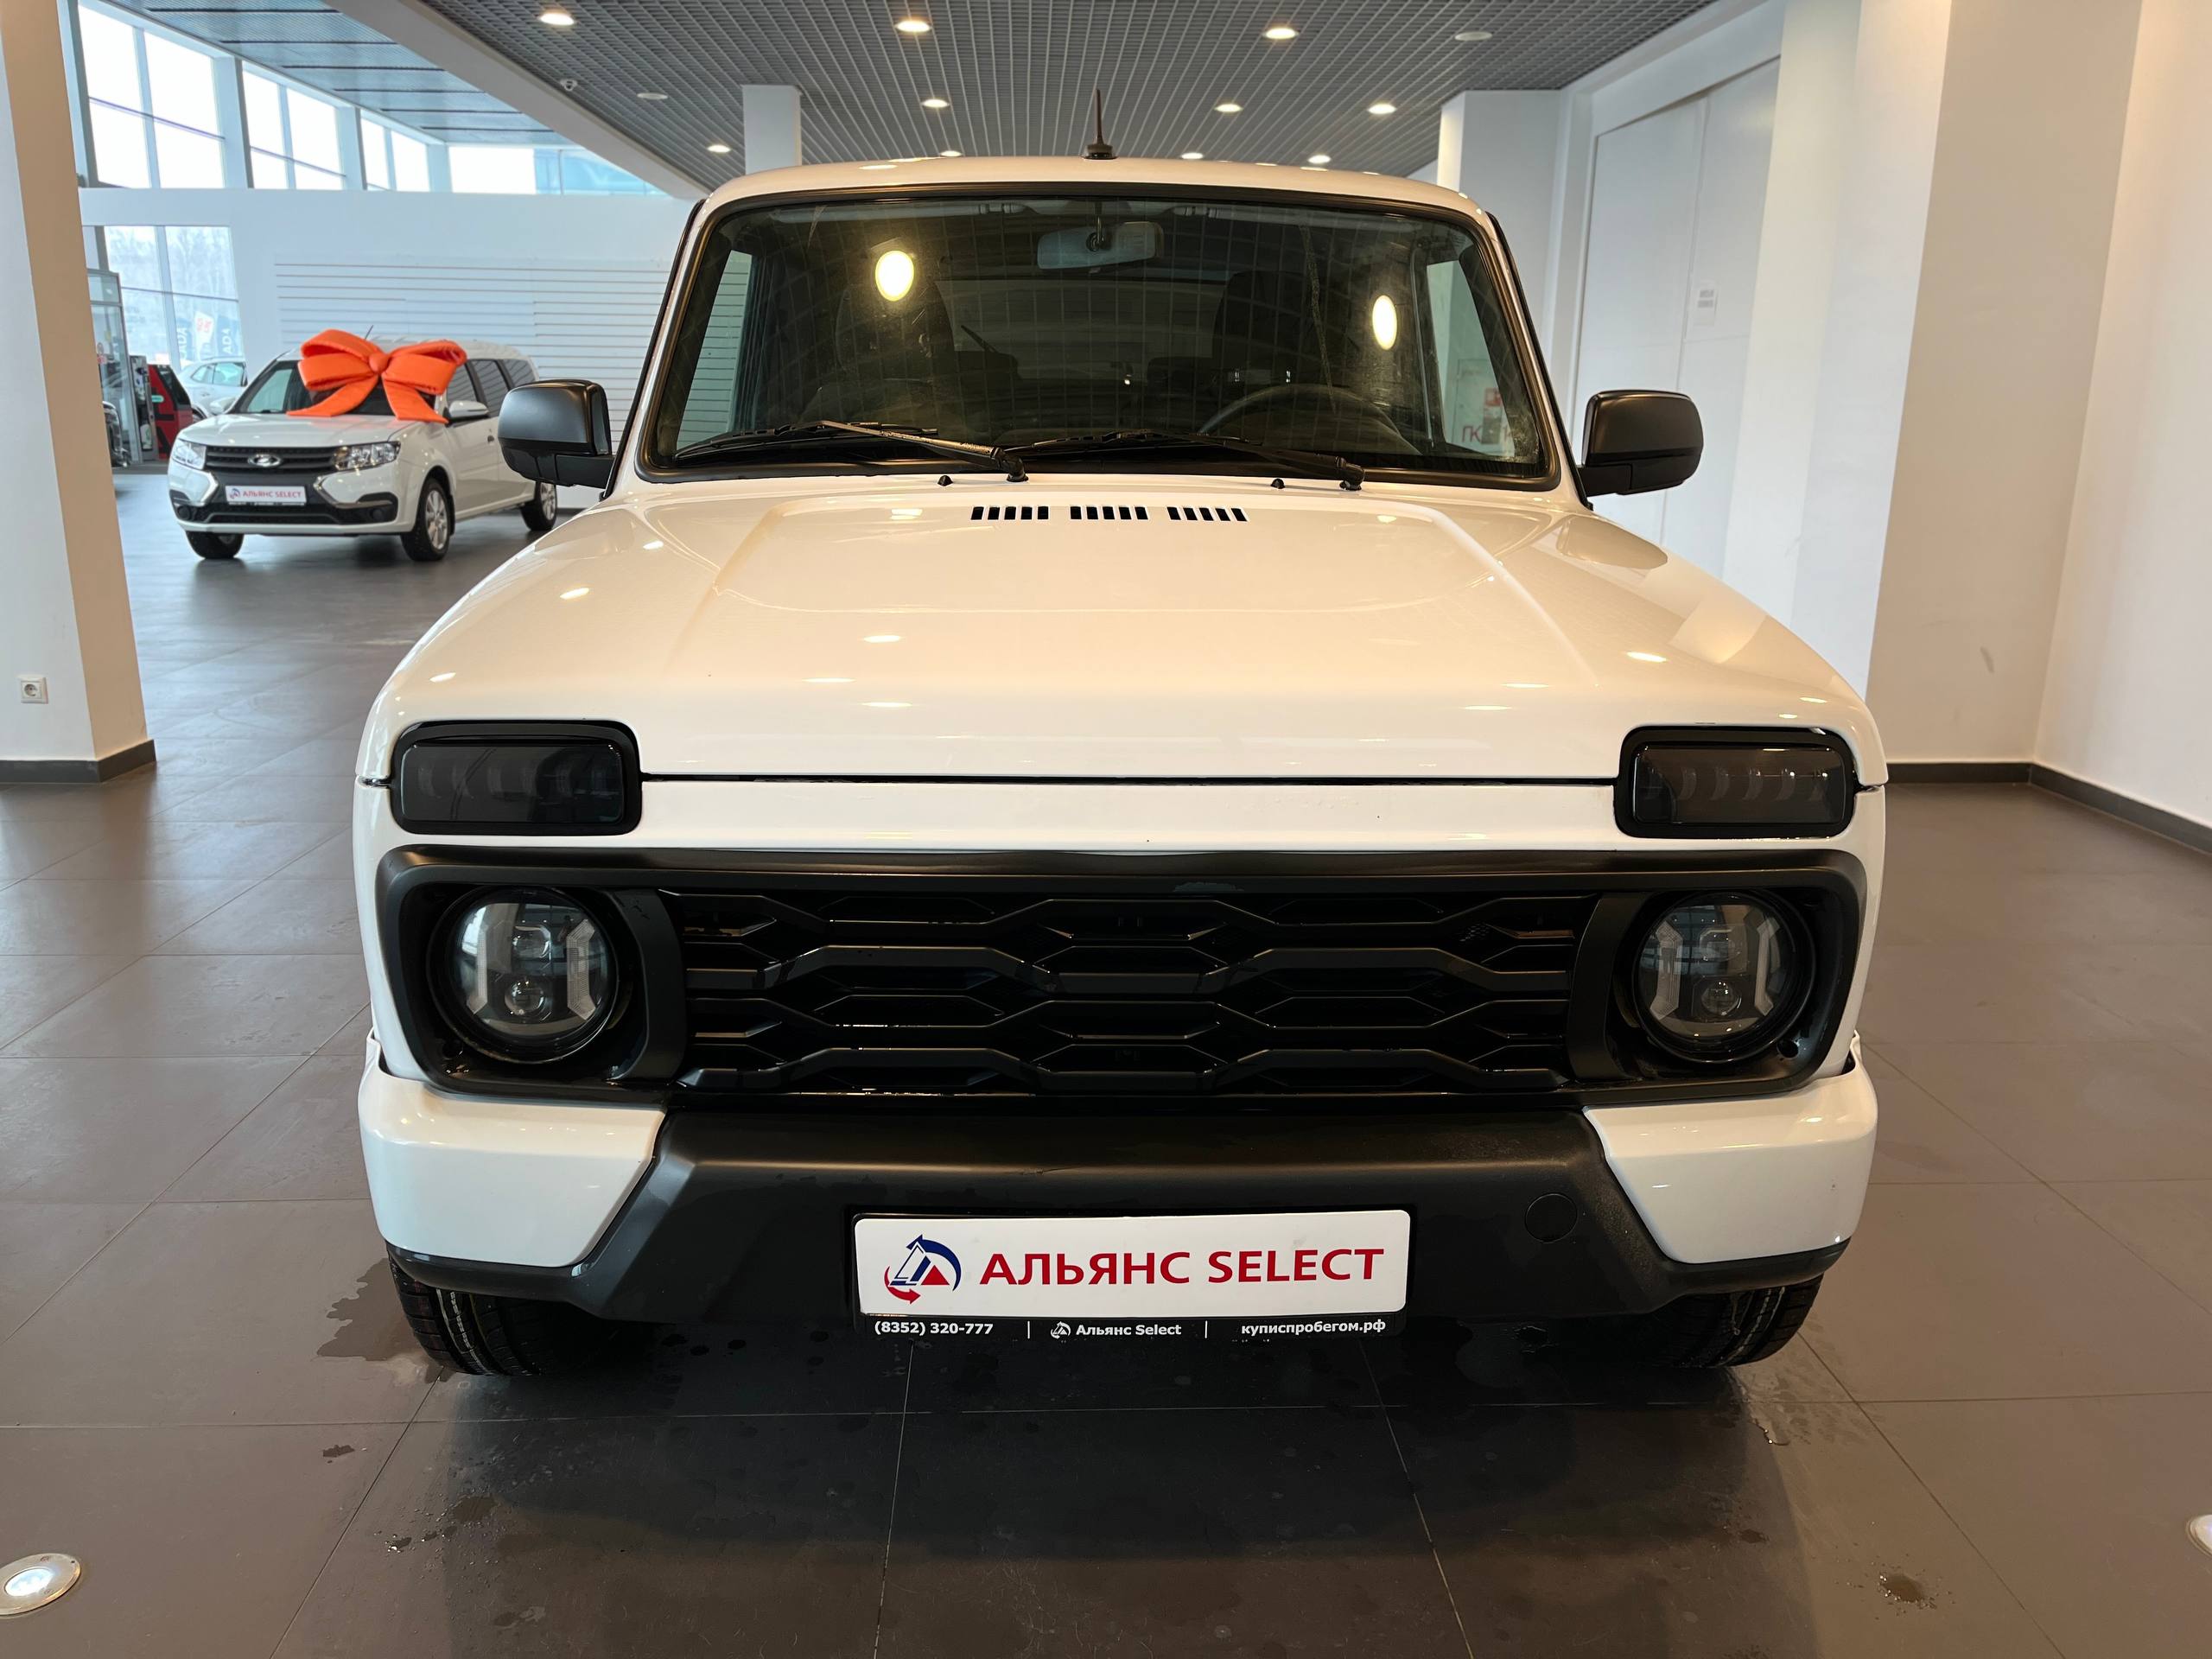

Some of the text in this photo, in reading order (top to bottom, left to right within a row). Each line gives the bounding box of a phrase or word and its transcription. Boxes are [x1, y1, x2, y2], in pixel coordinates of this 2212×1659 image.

[979, 1249, 1384, 1285] АЛЬЯНС SELECT
[874, 1320, 994, 1336] (8352) 320-777
[1076, 1323, 1182, 1336] Альянс Select
[1241, 1319, 1386, 1337] куписпробегом.рф
